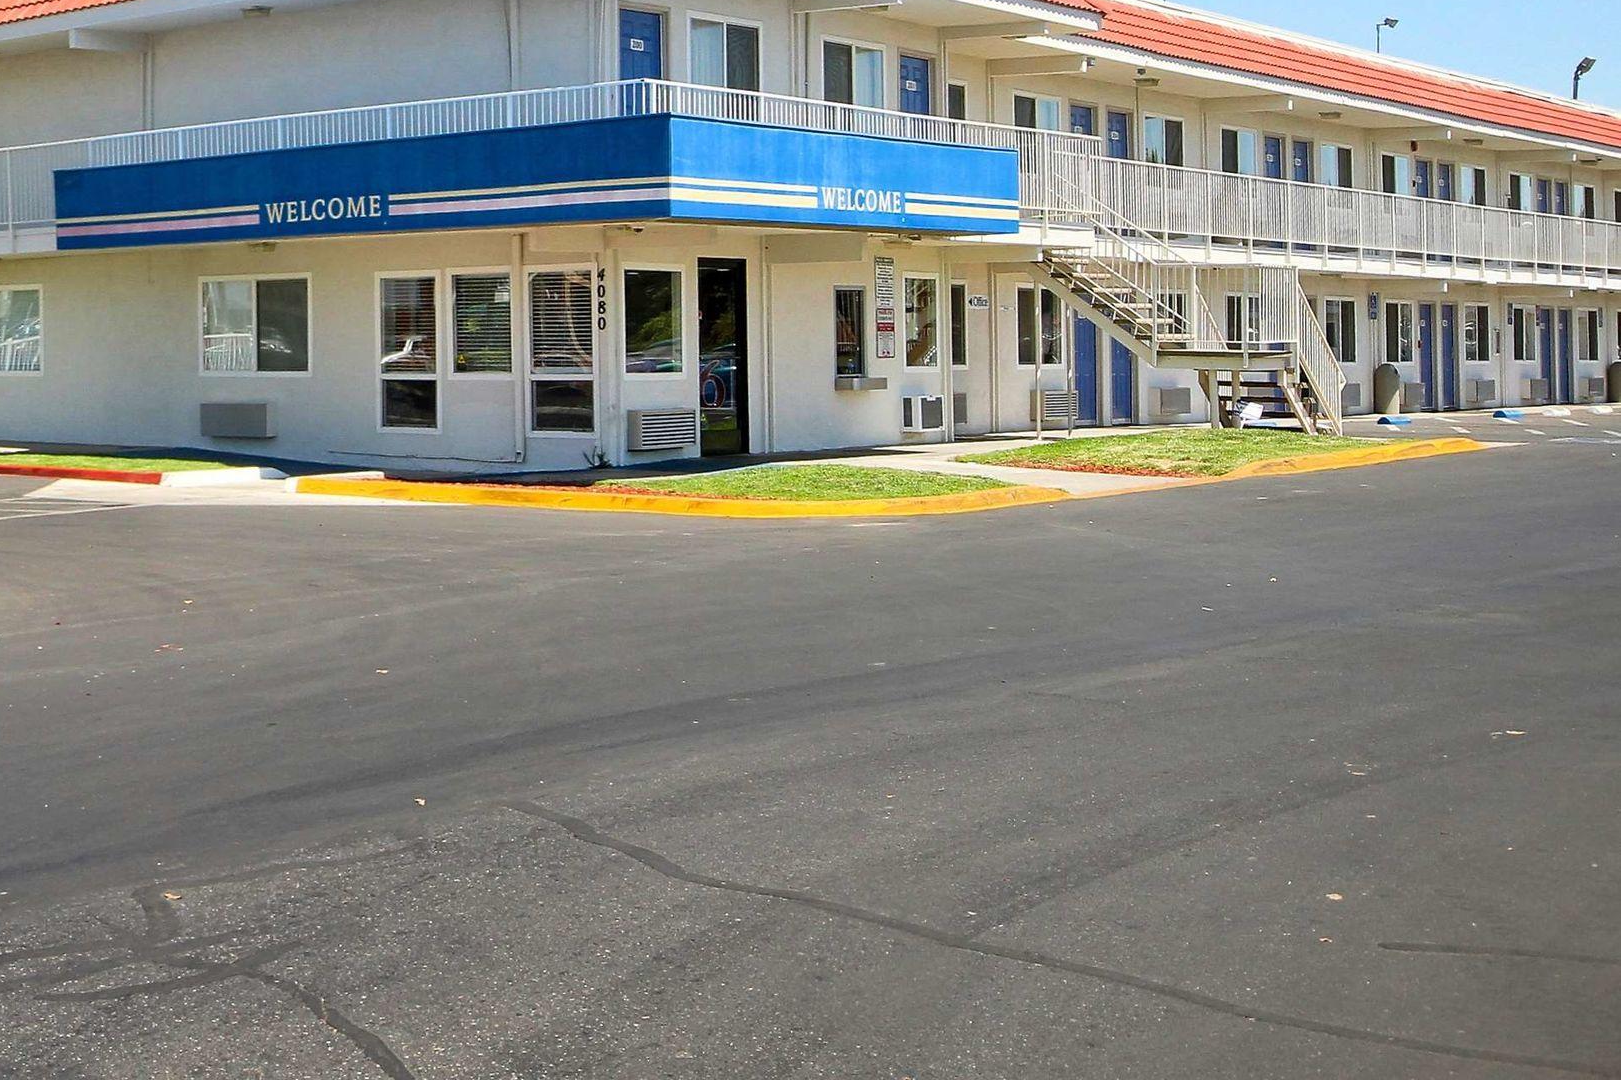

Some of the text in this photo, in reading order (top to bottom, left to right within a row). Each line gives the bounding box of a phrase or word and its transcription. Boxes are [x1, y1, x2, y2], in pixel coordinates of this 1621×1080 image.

[265, 195, 382, 224] WELCOME
[821, 186, 902, 214] WELCOME
[597, 268, 606, 330] 4080
